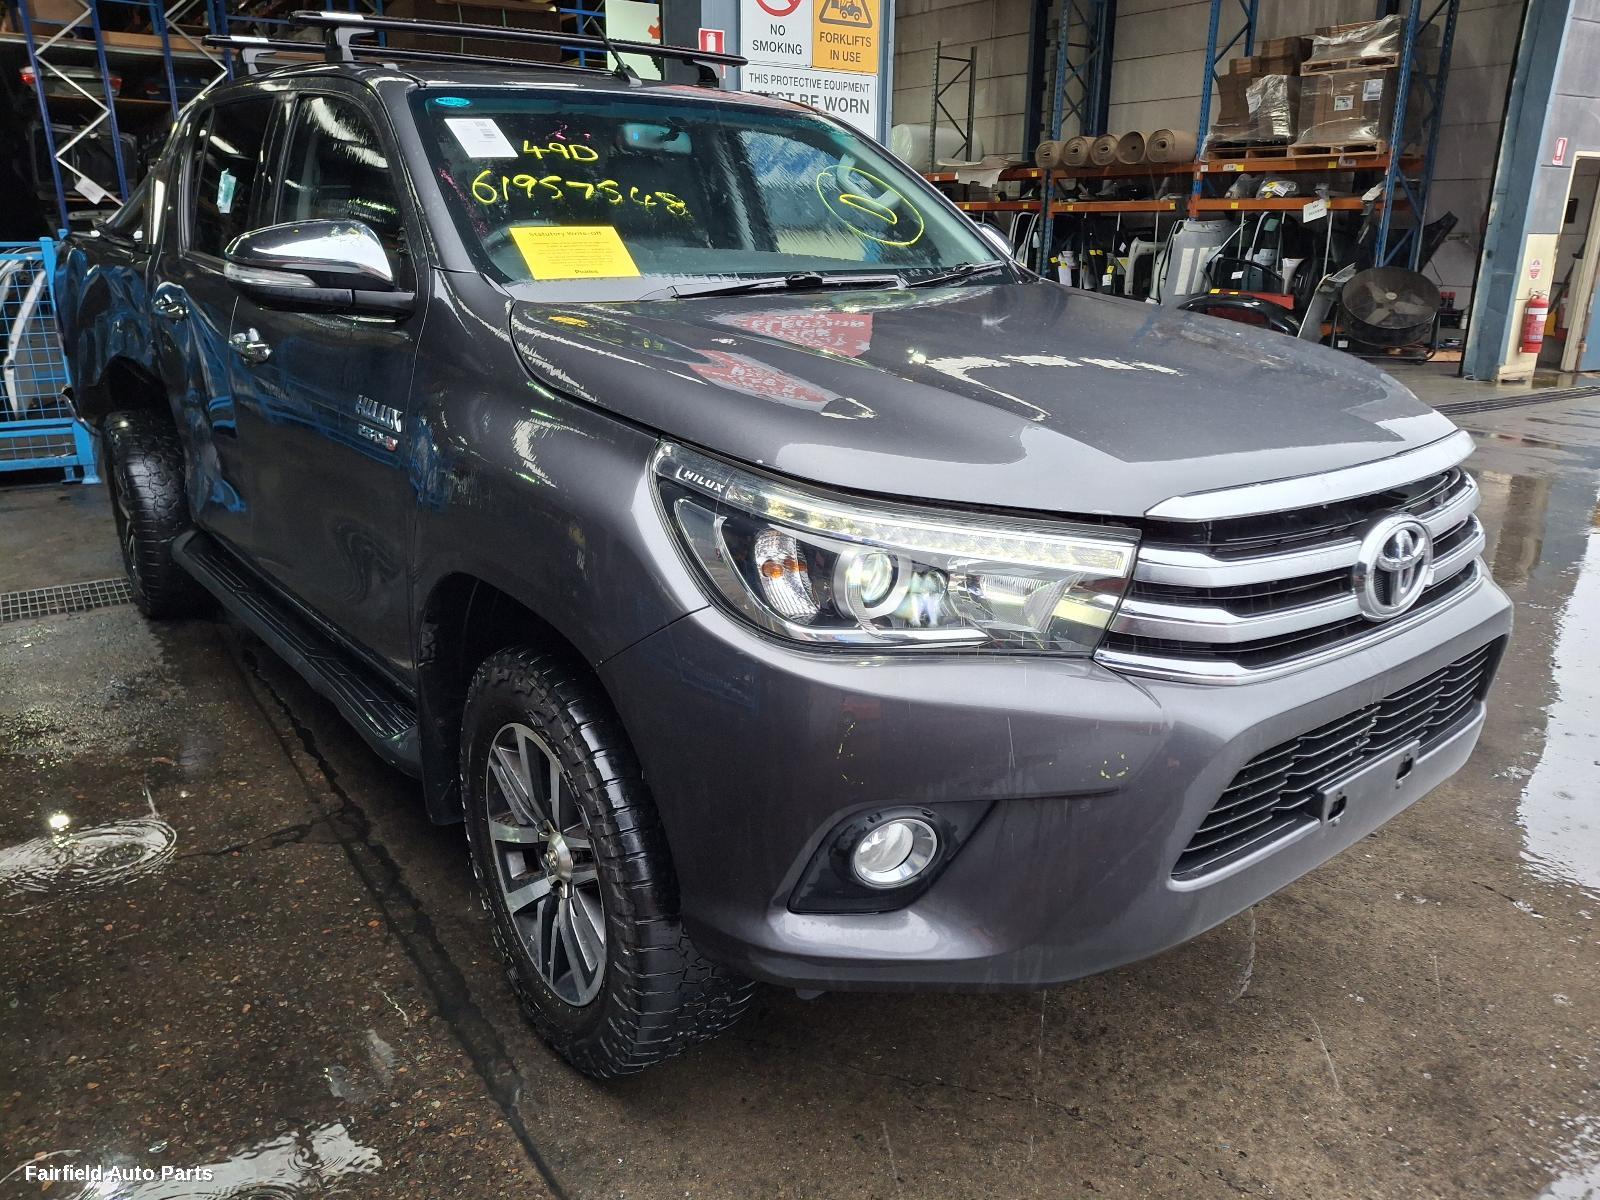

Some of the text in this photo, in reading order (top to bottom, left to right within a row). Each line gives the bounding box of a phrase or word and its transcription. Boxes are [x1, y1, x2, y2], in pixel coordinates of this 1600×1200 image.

[770, 23, 786, 36] NO
[752, 39, 803, 55] SMOKING
[819, 31, 872, 48] FORKLIFTS
[830, 49, 861, 63] IN USE
[749, 72, 871, 93] THIS PROTECTIVE EQUIPMENT
[823, 95, 870, 114] WORN
[355, 394, 403, 433] HILUX
[683, 470, 725, 493] HILUX
